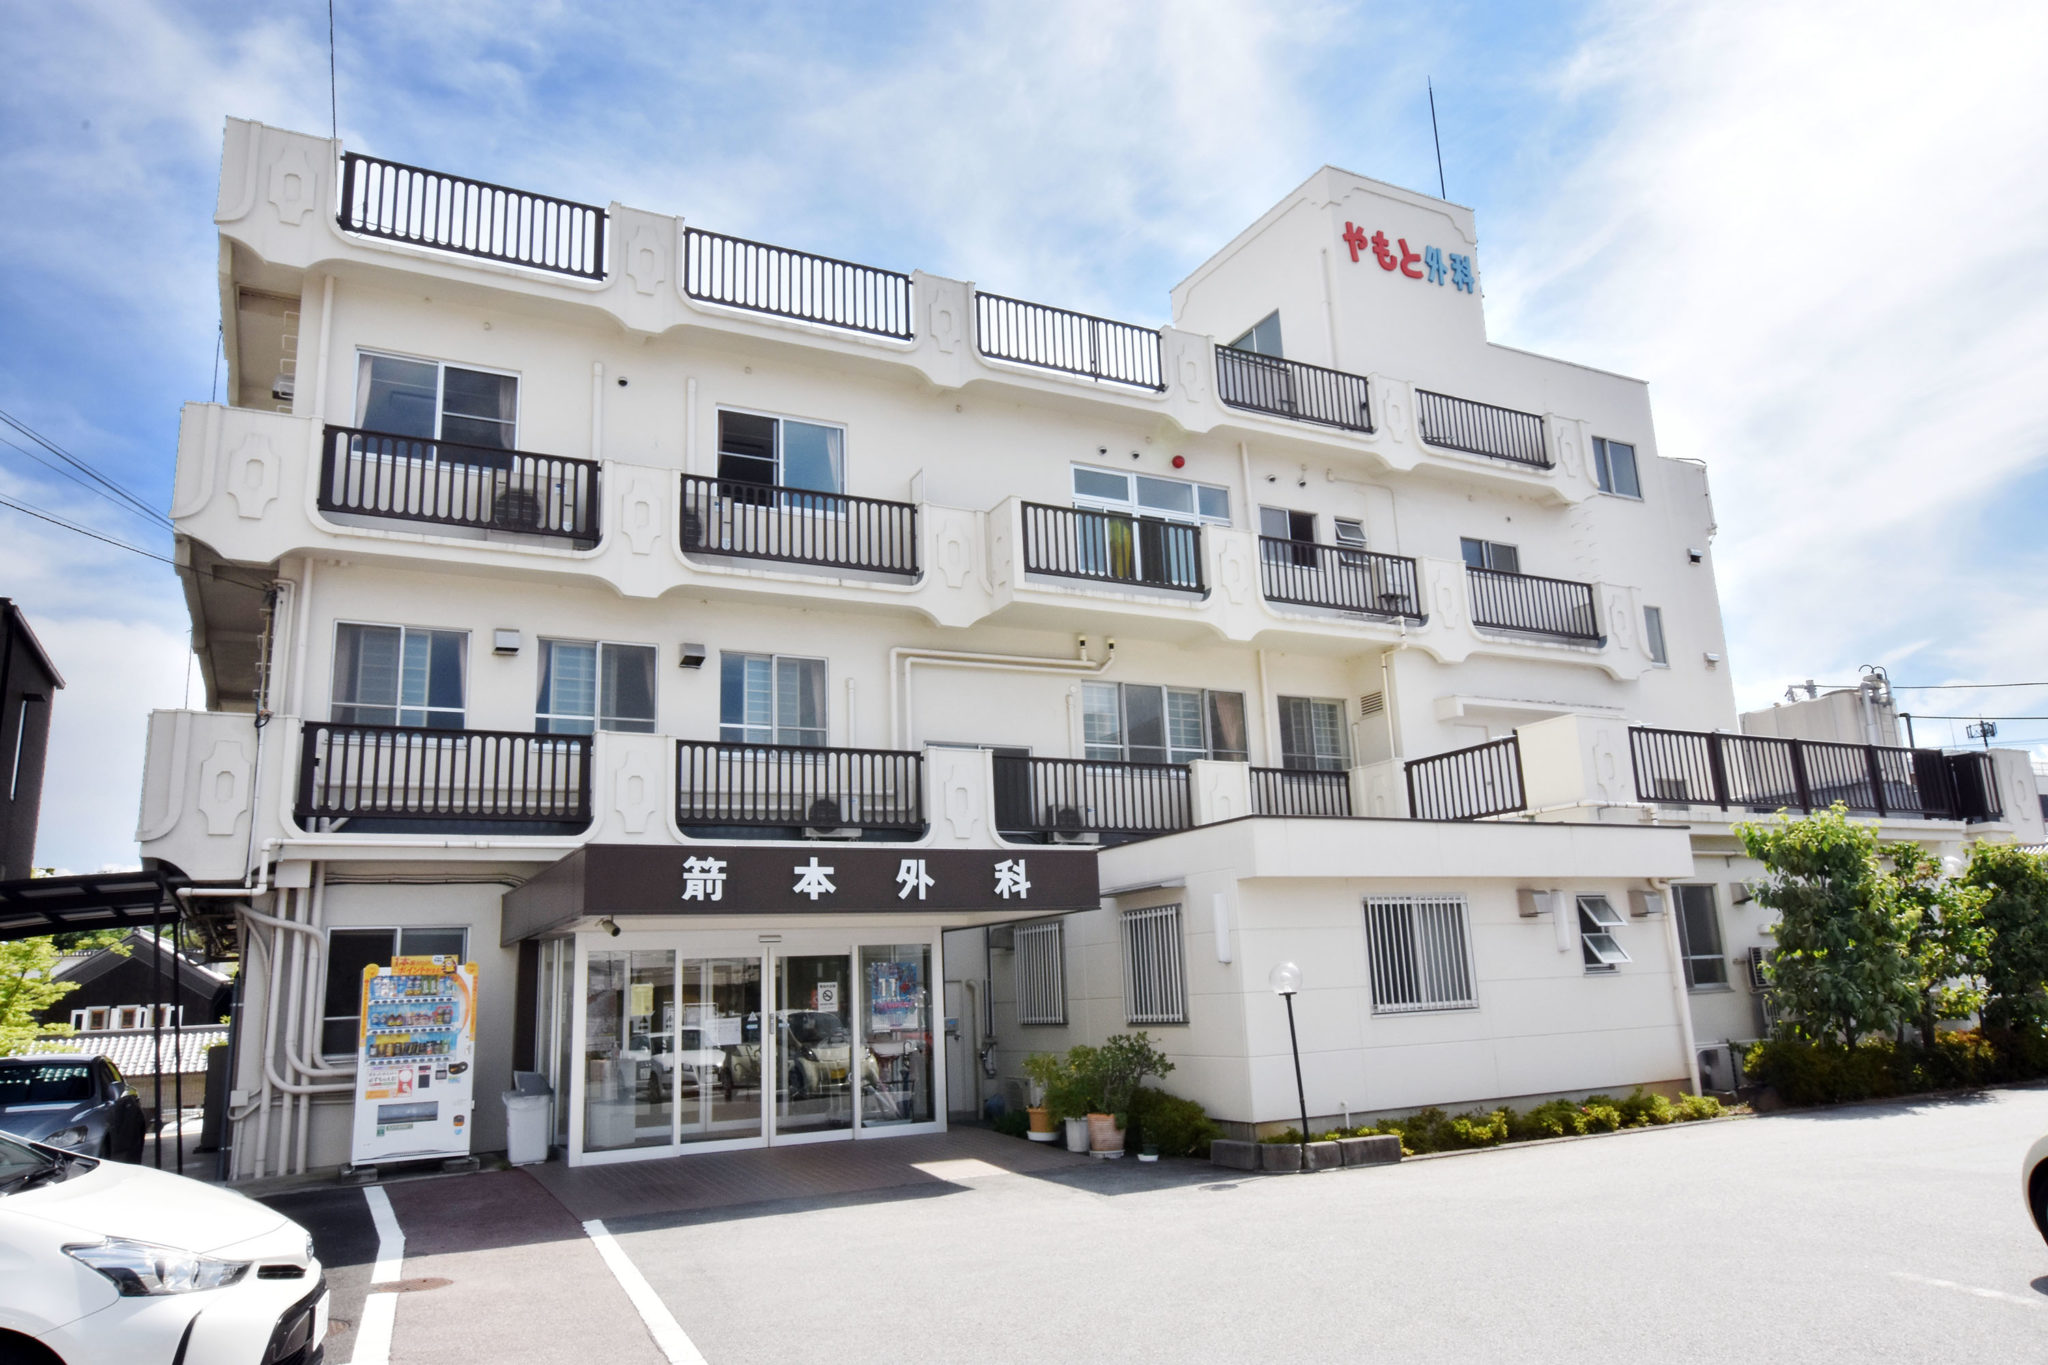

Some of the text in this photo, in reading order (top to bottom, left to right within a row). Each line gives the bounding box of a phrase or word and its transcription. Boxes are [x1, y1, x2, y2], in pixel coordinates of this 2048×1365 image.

[1342, 221, 1475, 294] やもと外科
[682, 856, 1031, 901] 箭本外科
